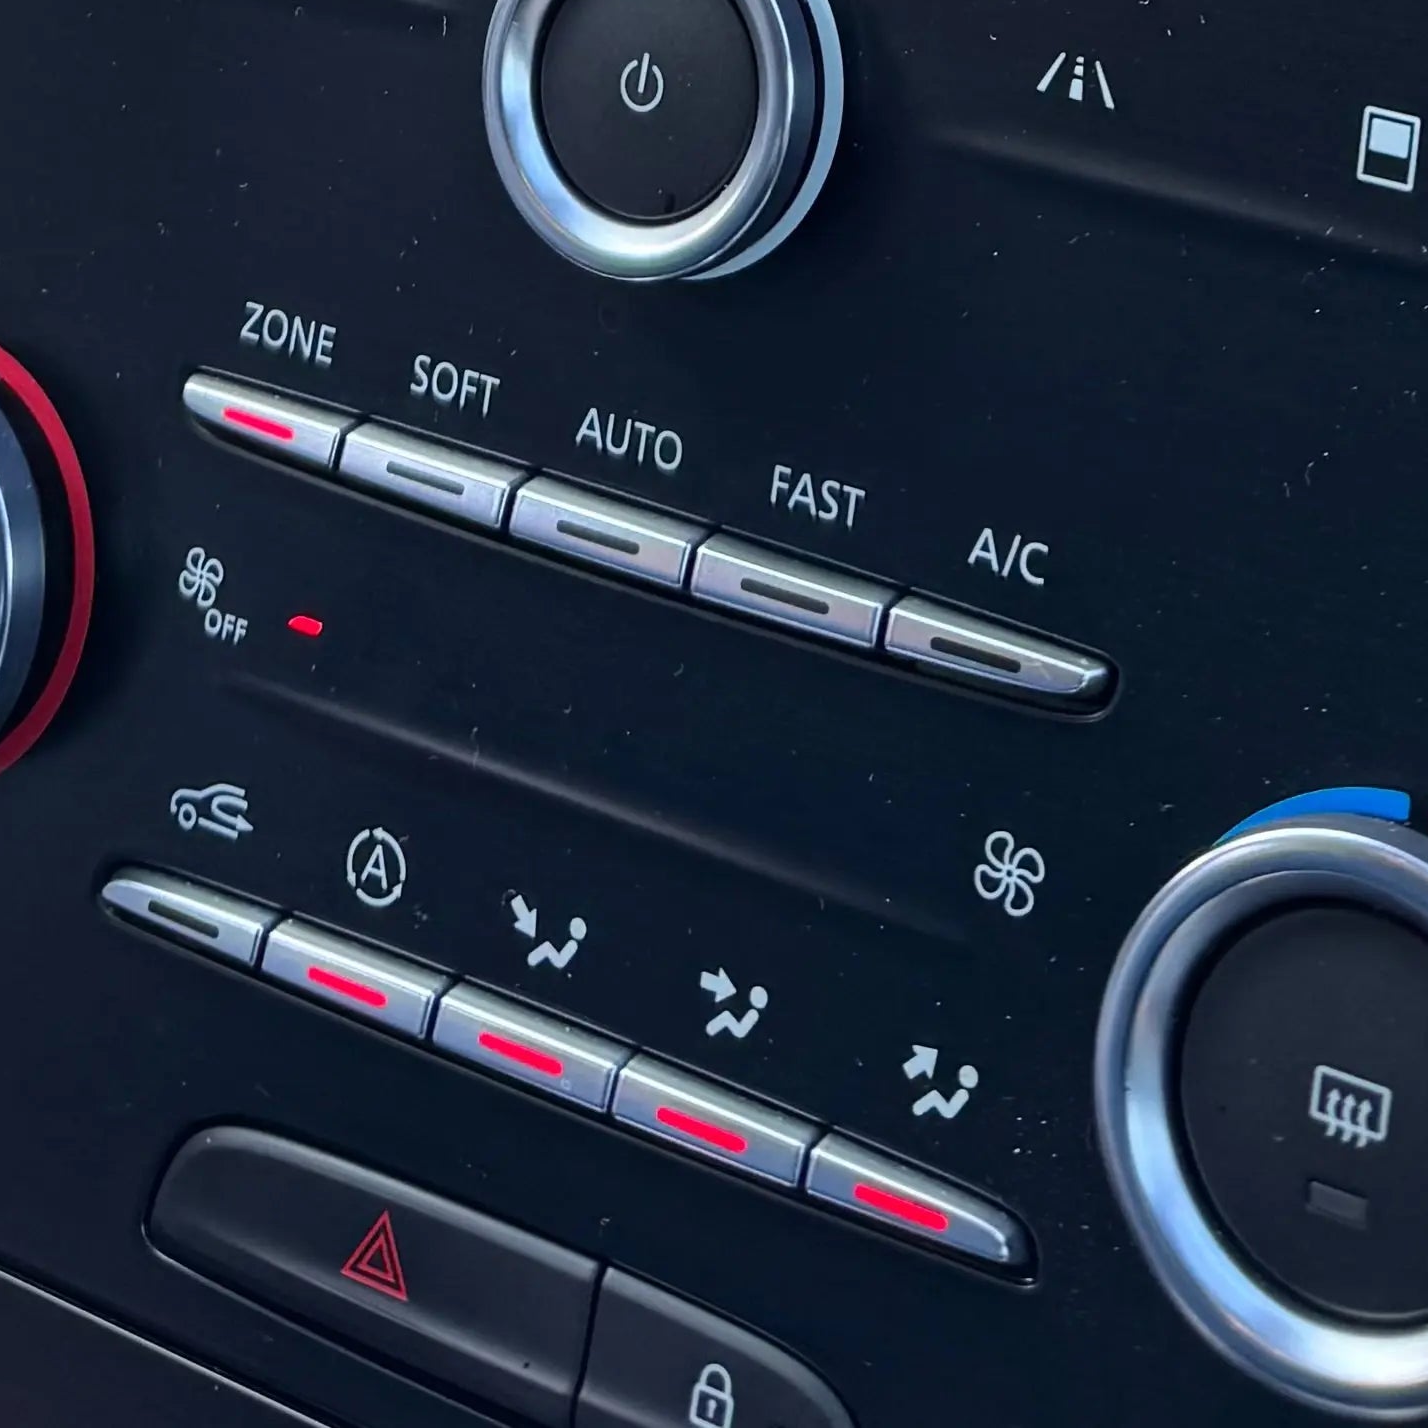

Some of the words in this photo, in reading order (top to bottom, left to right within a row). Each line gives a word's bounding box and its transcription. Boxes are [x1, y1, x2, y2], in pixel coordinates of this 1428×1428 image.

[239, 300, 337, 366] ZONE
[409, 354, 500, 418] SOFT
[575, 407, 683, 473] AUTO
[770, 463, 865, 530] FAST
[968, 527, 1049, 587] A/C
[203, 606, 249, 646] OFF
